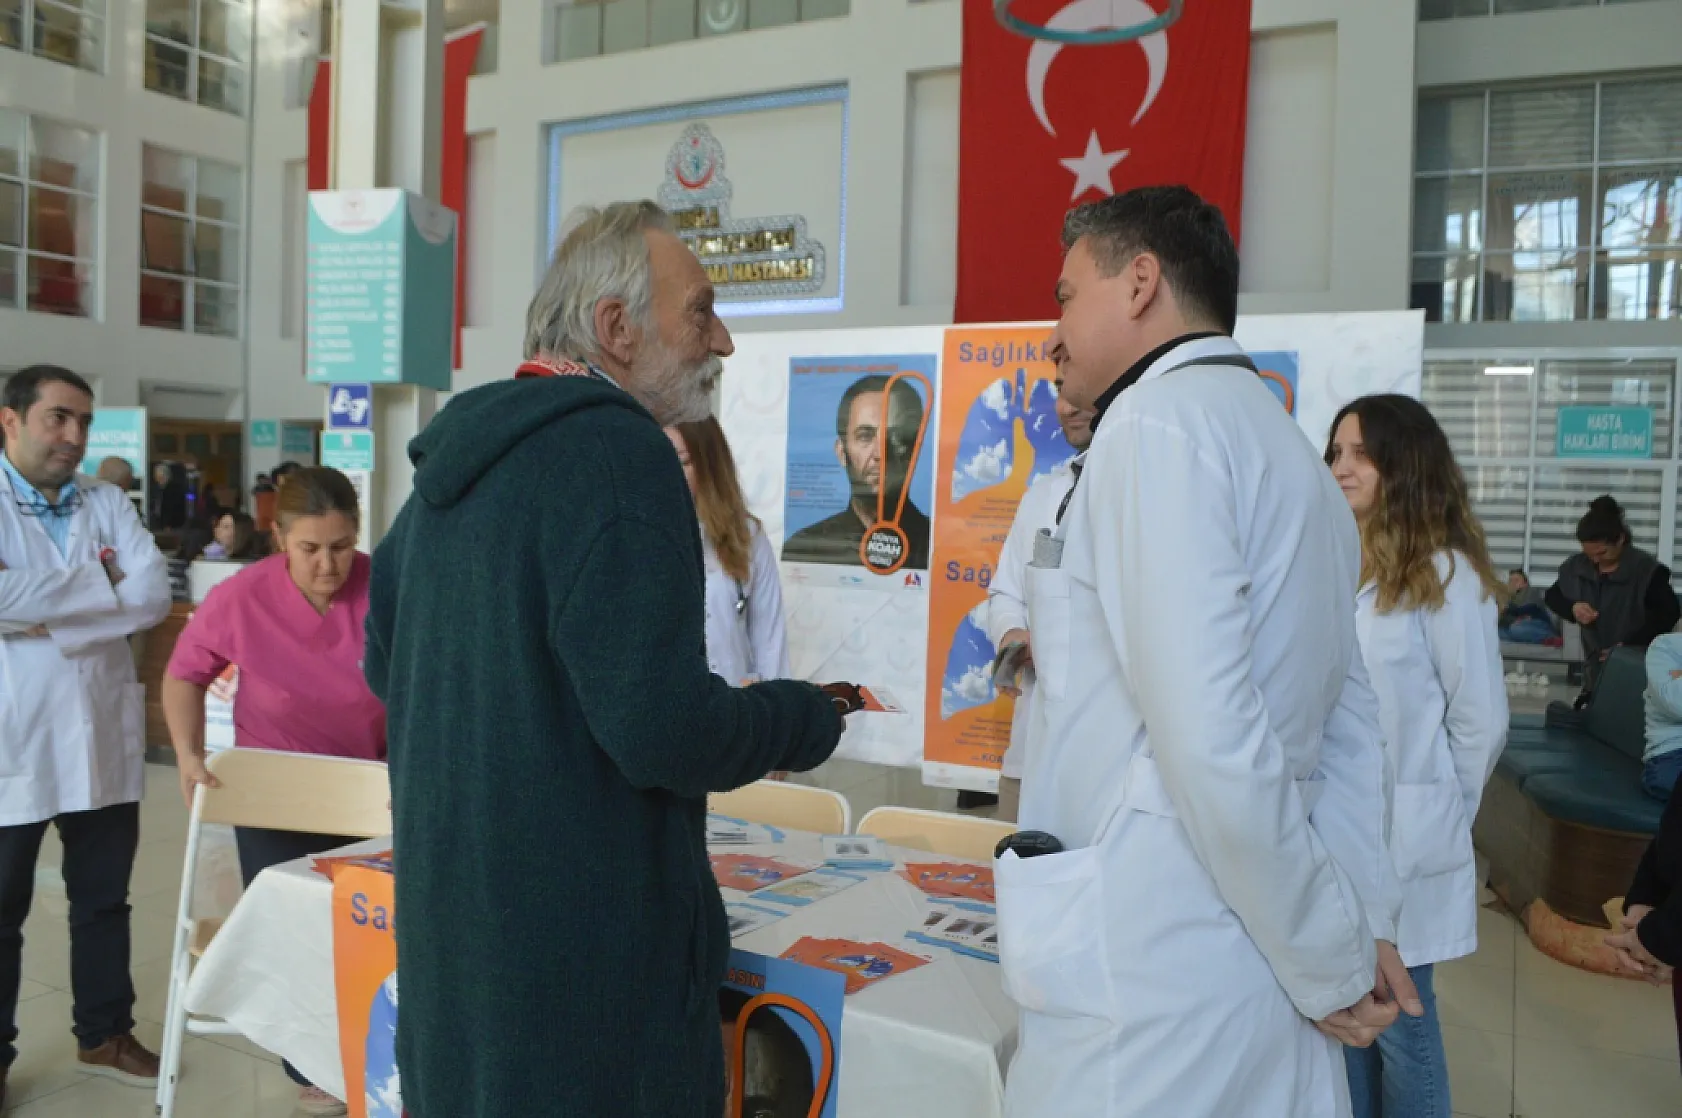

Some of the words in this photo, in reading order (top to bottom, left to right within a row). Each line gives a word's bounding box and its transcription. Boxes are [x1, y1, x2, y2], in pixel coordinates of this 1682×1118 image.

[1587, 413, 1622, 430] HASTA
[89, 429, 138, 446] ANIŞMA
[1563, 433, 1610, 450] HAKLARI
[867, 540, 902, 556] KOAH
[946, 559, 994, 589] Sağ
